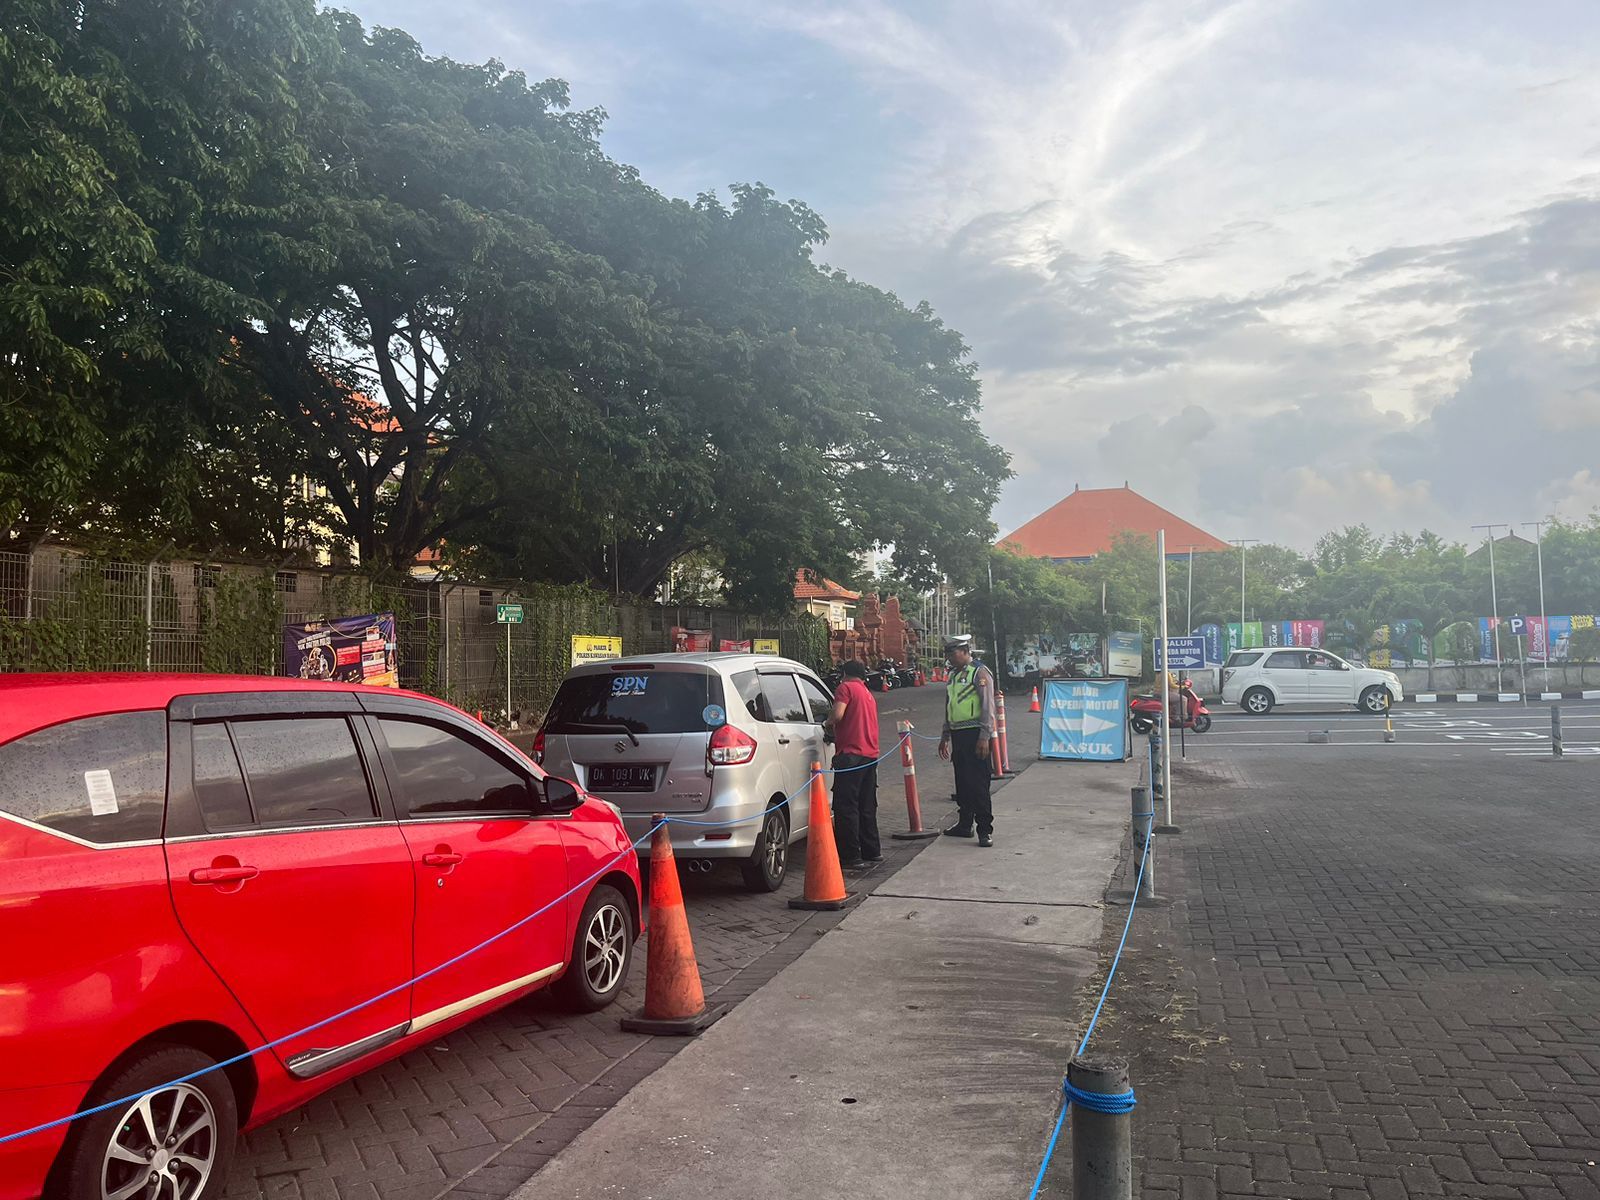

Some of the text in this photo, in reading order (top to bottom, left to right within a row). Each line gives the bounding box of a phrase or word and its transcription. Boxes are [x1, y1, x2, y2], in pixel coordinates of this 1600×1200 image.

[1511, 619, 1523, 633] P
[612, 676, 649, 691] SPN
[1071, 686, 1099, 697] JALUR
[1050, 699, 1120, 711] SEPEDA MOTOR
[1051, 741, 1114, 755] MASUK
